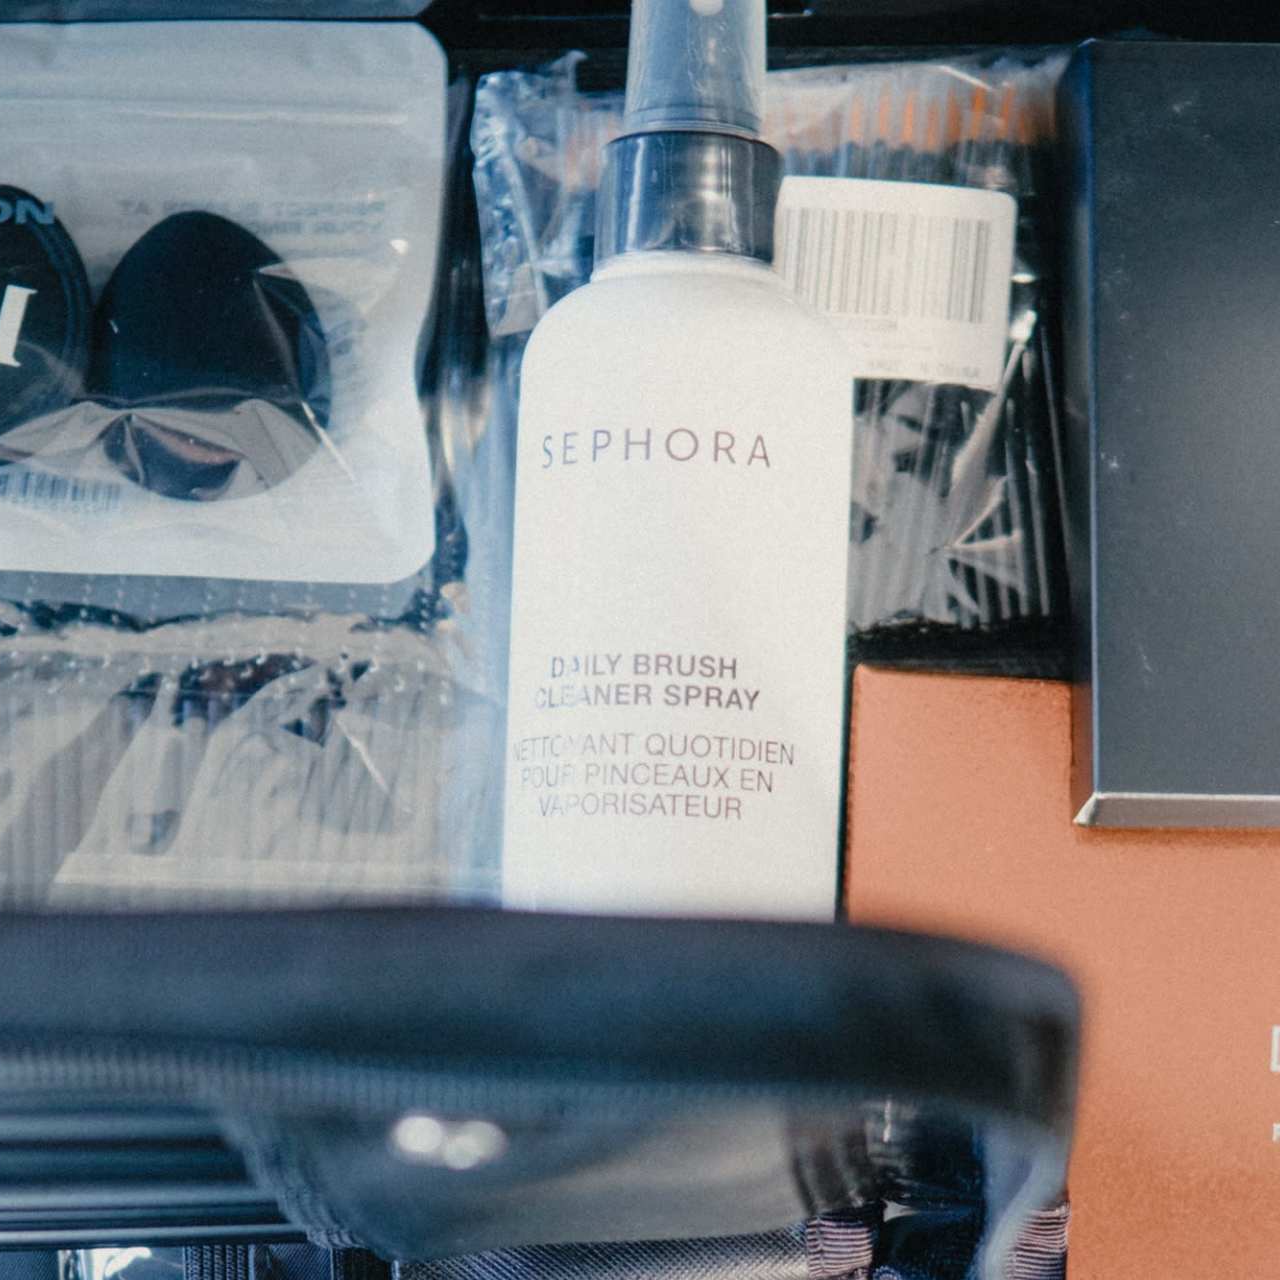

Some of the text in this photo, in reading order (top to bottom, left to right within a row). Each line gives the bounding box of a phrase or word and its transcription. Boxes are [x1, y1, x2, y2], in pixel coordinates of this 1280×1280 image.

[542, 428, 771, 469] SEPHORA
[632, 653, 738, 680] BRUSH
[534, 684, 761, 712] CLEANER SPRAY
[645, 733, 795, 766] QUOTIDIEN
[584, 762, 730, 791] PINCEAUX
[739, 768, 774, 794] EN
[537, 792, 743, 821] VAPORISATEUR
